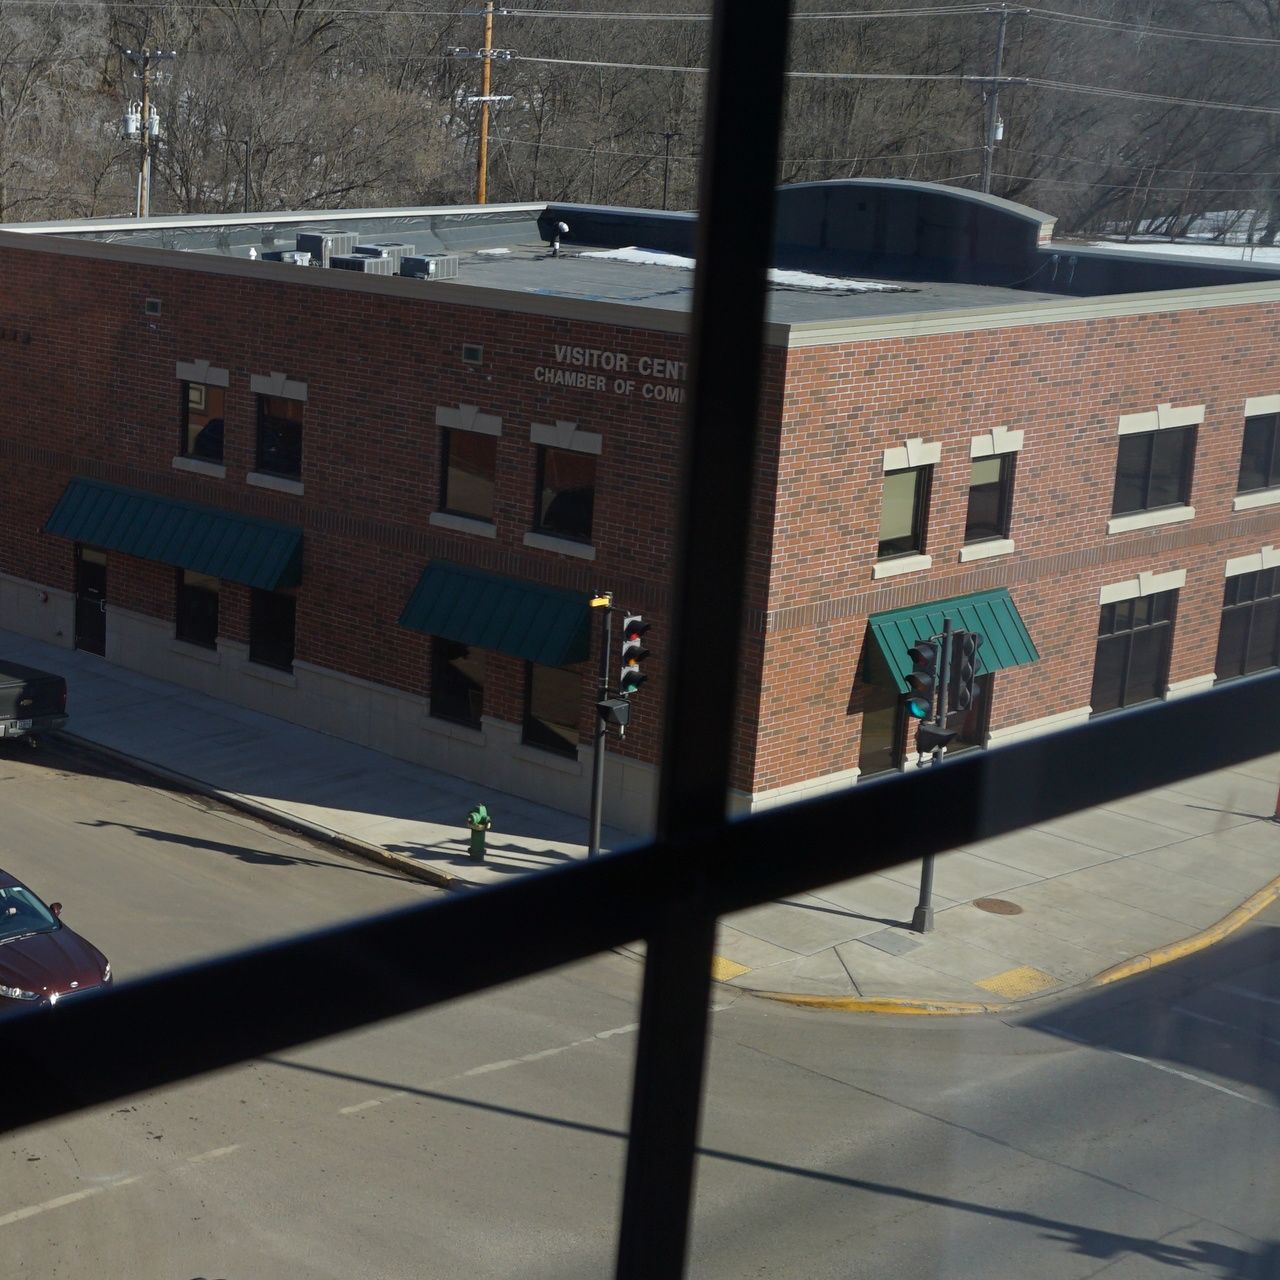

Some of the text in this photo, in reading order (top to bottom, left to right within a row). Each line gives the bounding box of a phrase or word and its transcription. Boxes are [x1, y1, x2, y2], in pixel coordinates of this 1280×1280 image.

[554, 344, 629, 372] VISITOR
[533, 366, 606, 391] CHAMBER
[614, 379, 635, 396] OF
